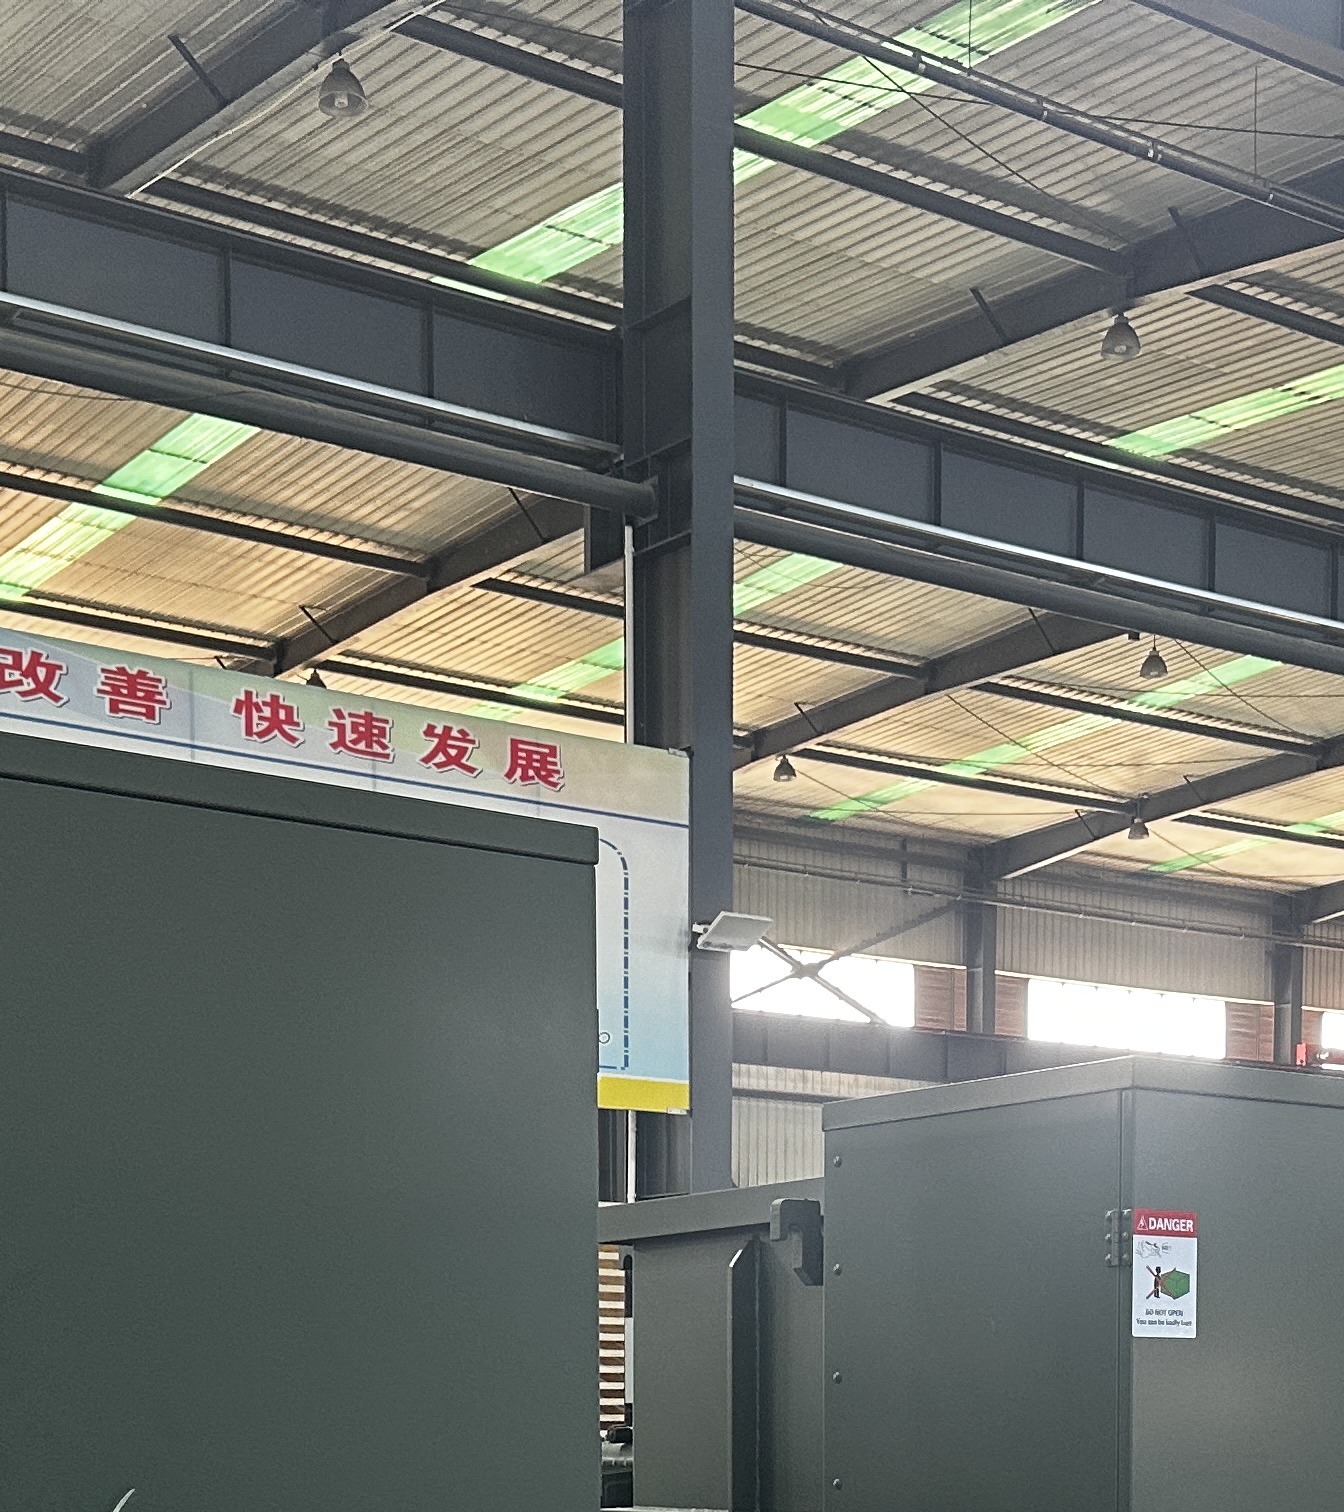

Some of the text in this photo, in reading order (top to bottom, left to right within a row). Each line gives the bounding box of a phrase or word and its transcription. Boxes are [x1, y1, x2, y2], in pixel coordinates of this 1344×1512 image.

[232, 687, 567, 790] 快速发展
[1148, 1217, 1194, 1233] DANGER
